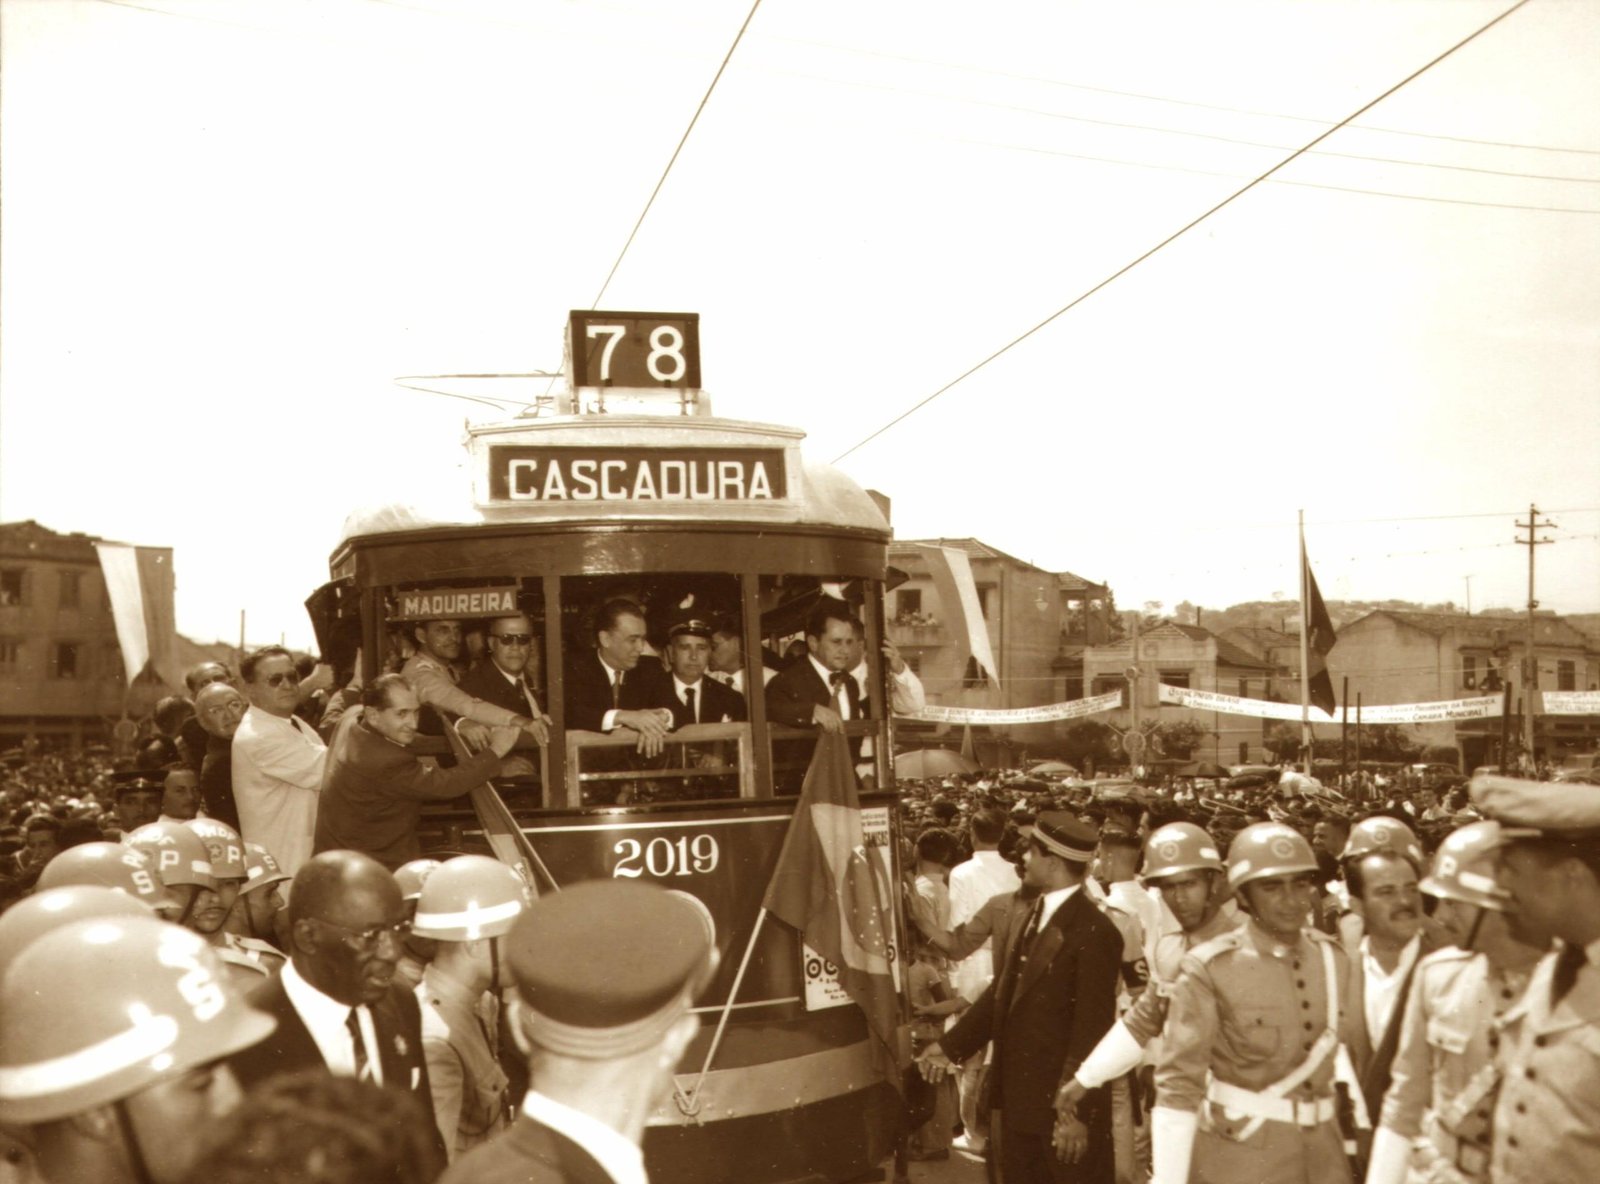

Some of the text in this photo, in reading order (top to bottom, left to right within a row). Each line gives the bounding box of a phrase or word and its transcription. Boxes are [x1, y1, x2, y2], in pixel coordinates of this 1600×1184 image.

[586, 325, 686, 381] 78
[508, 459, 773, 500] CASCADURA
[404, 592, 514, 616] MADUREIRA
[159, 850, 180, 872] P
[227, 845, 241, 864] P
[613, 833, 720, 879] 2019
[130, 869, 155, 895] S
[177, 965, 226, 1023] S
